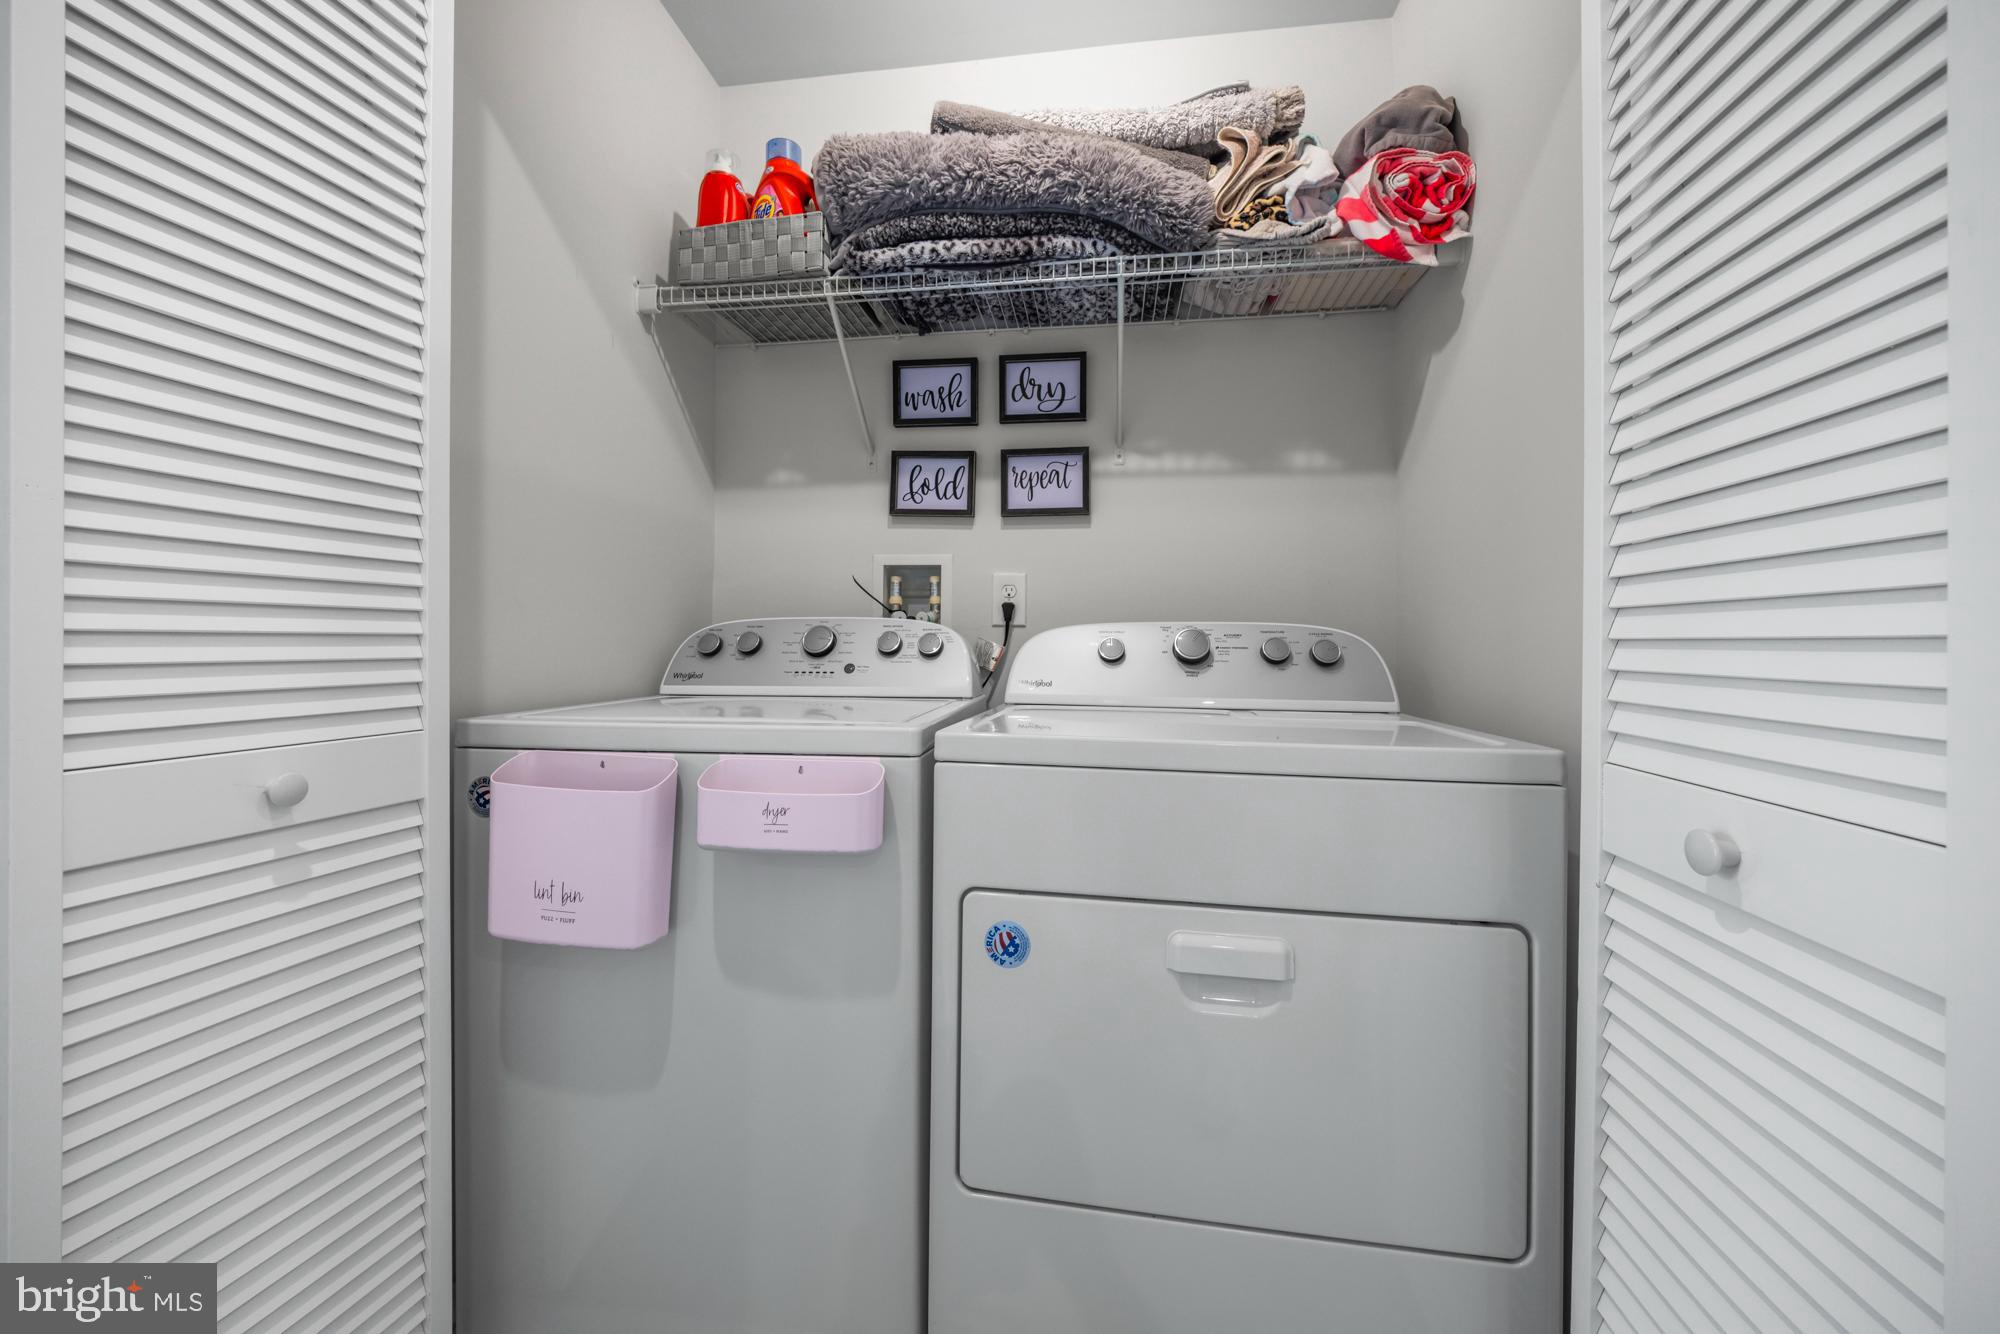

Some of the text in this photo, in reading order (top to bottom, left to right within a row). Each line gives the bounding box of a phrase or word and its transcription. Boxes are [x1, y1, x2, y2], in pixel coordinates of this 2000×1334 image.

[755, 202, 772, 218] Tide
[905, 373, 967, 413] wash
[1012, 366, 1077, 412] dry
[903, 464, 966, 504] fold
[1012, 461, 1077, 502] repeat
[673, 671, 704, 681] Whirlpool
[761, 801, 791, 825] dryer
[534, 880, 584, 906] lint bin
